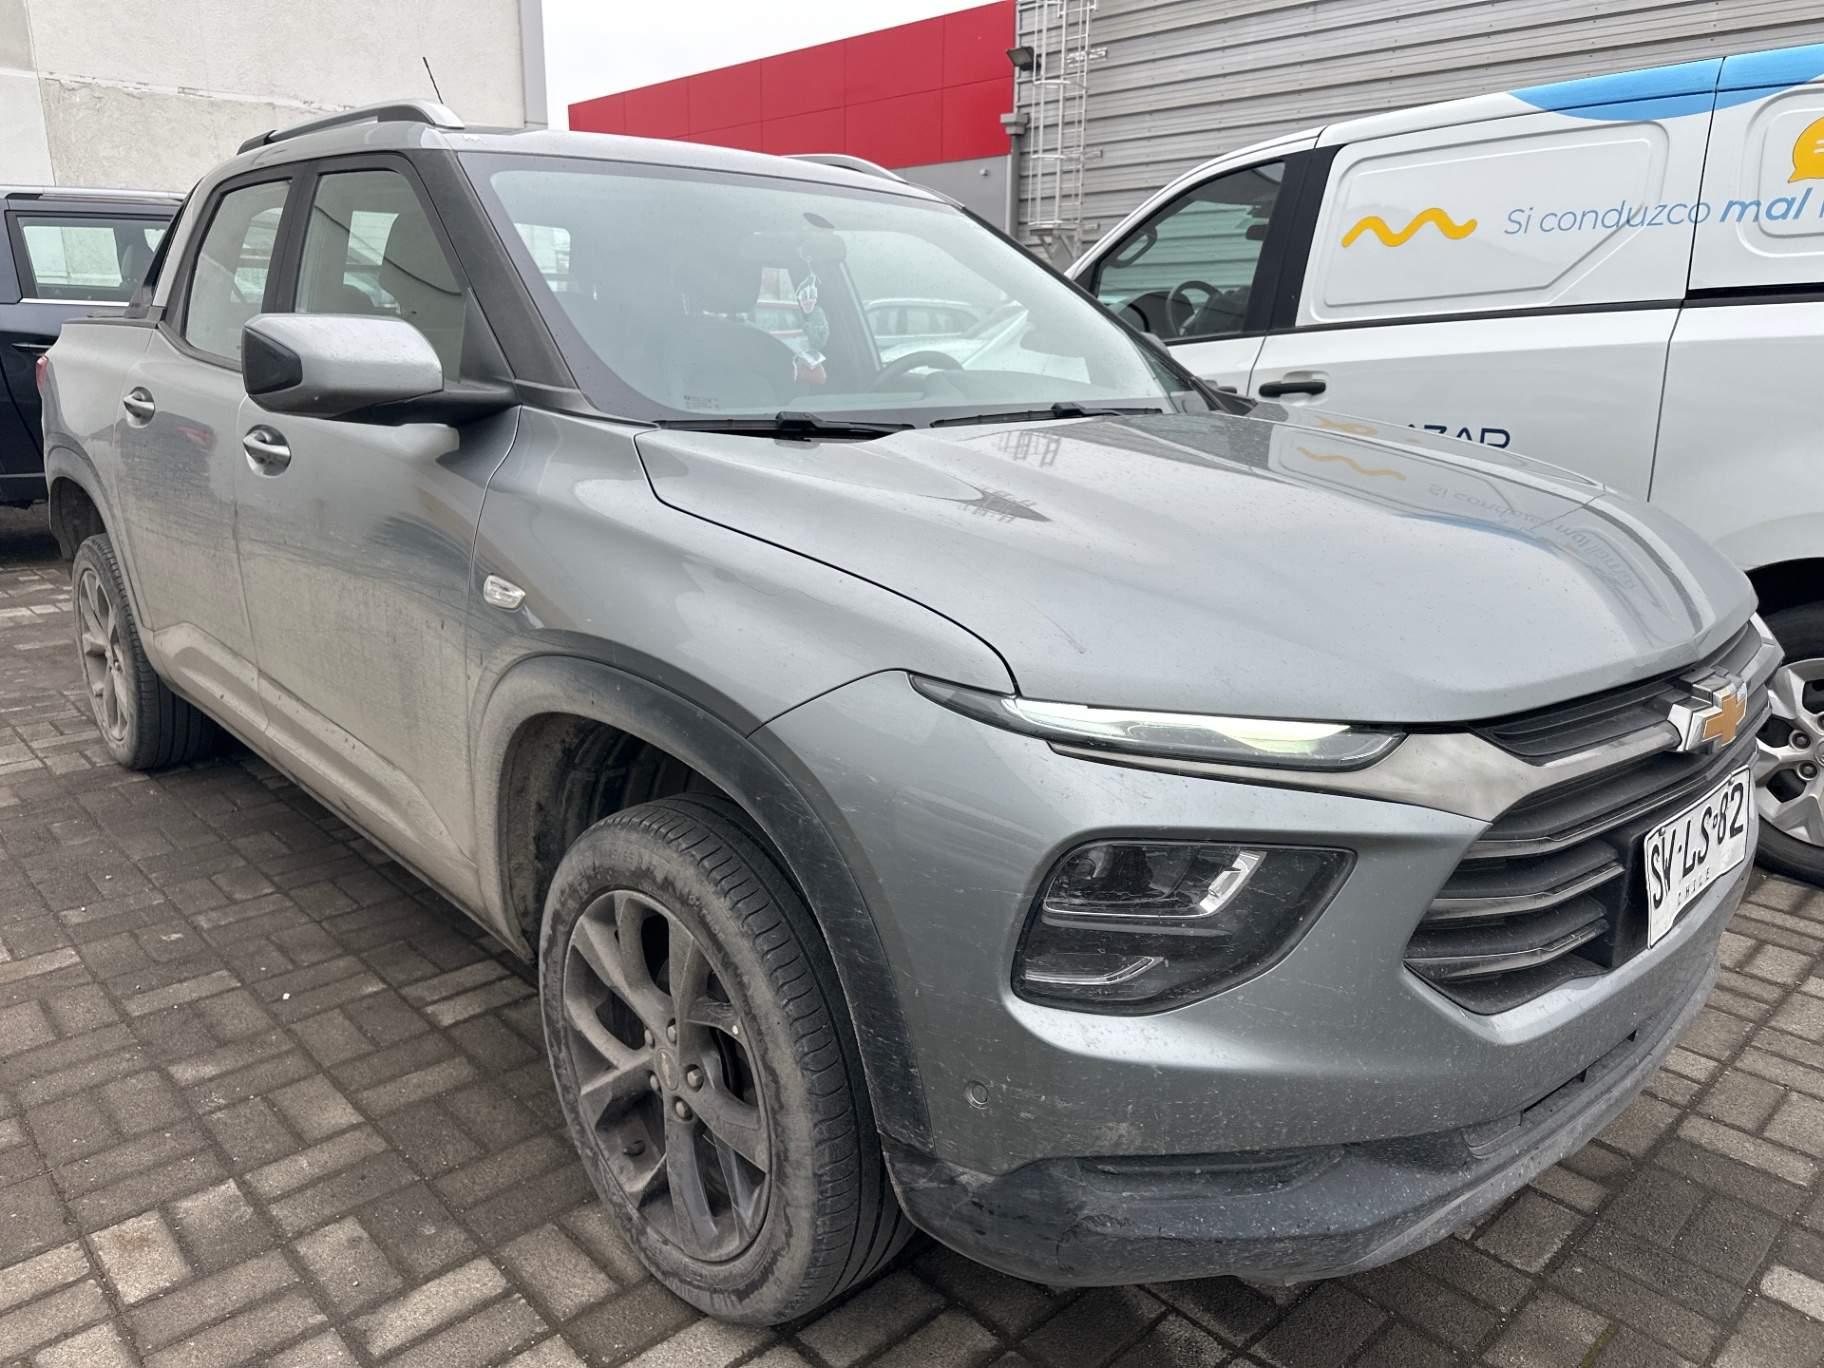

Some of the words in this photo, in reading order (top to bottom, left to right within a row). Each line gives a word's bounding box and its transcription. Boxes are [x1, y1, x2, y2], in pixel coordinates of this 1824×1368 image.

[1503, 206, 1534, 235] Si
[1539, 199, 1711, 233] conduzco
[1719, 187, 1813, 223] mal
